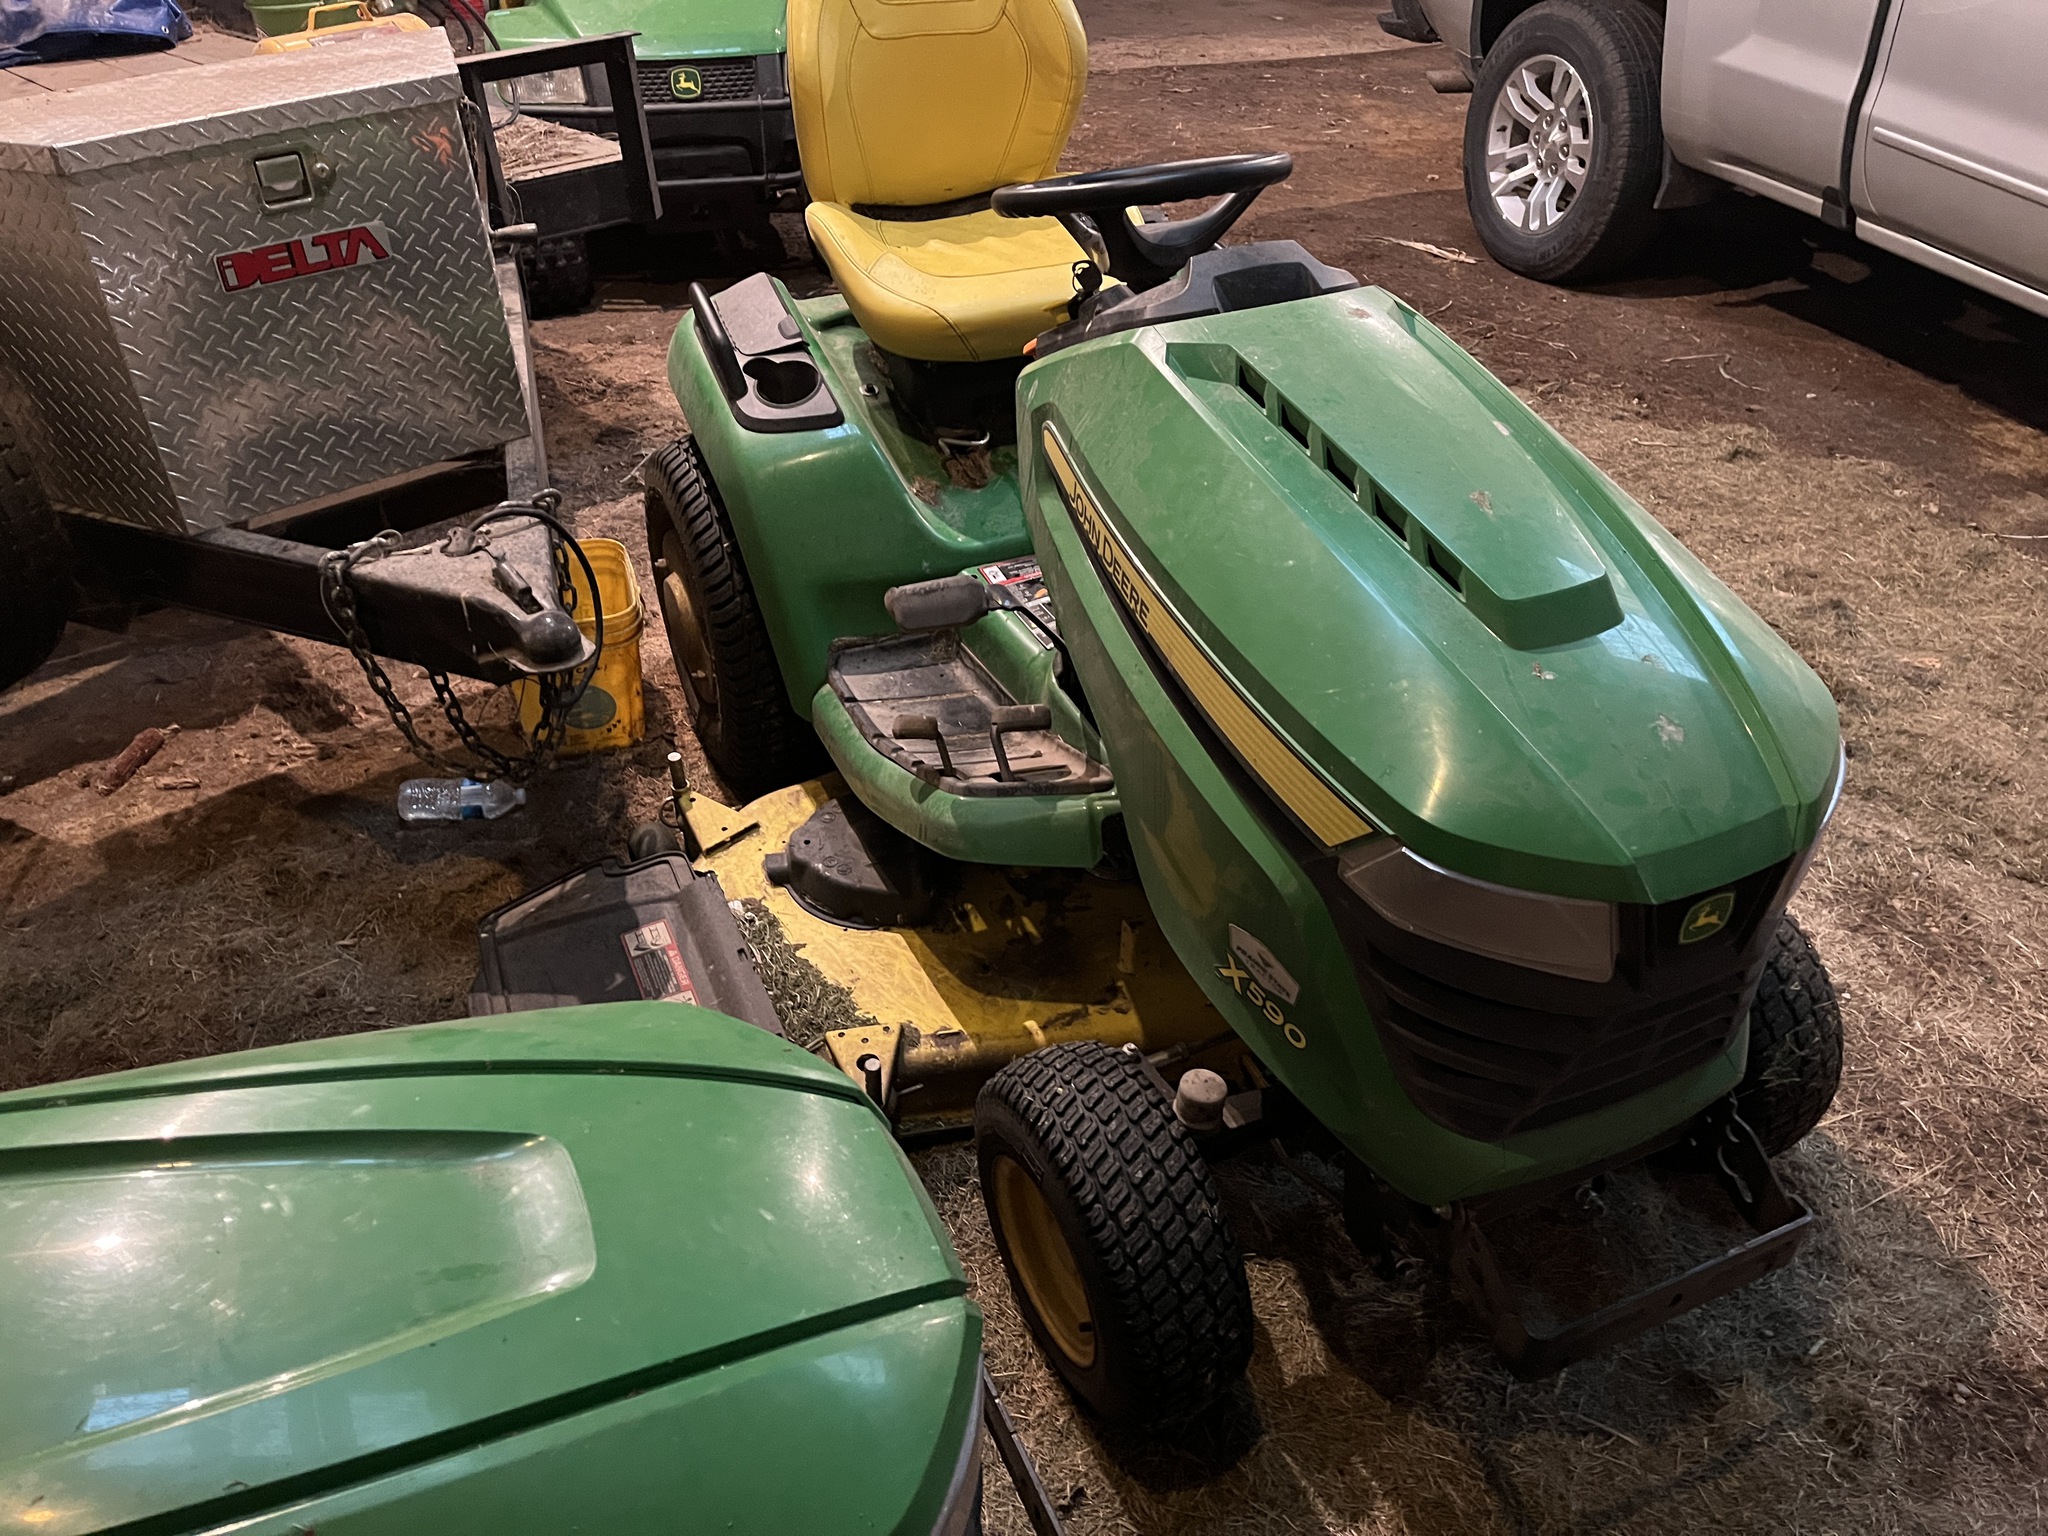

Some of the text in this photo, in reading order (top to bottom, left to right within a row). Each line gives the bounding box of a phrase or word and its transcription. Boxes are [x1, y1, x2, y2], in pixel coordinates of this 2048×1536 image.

[1070, 481, 1150, 629] JOHN DEERE
[672, 955, 690, 987] DANGER
[1218, 952, 1307, 1049] X590
